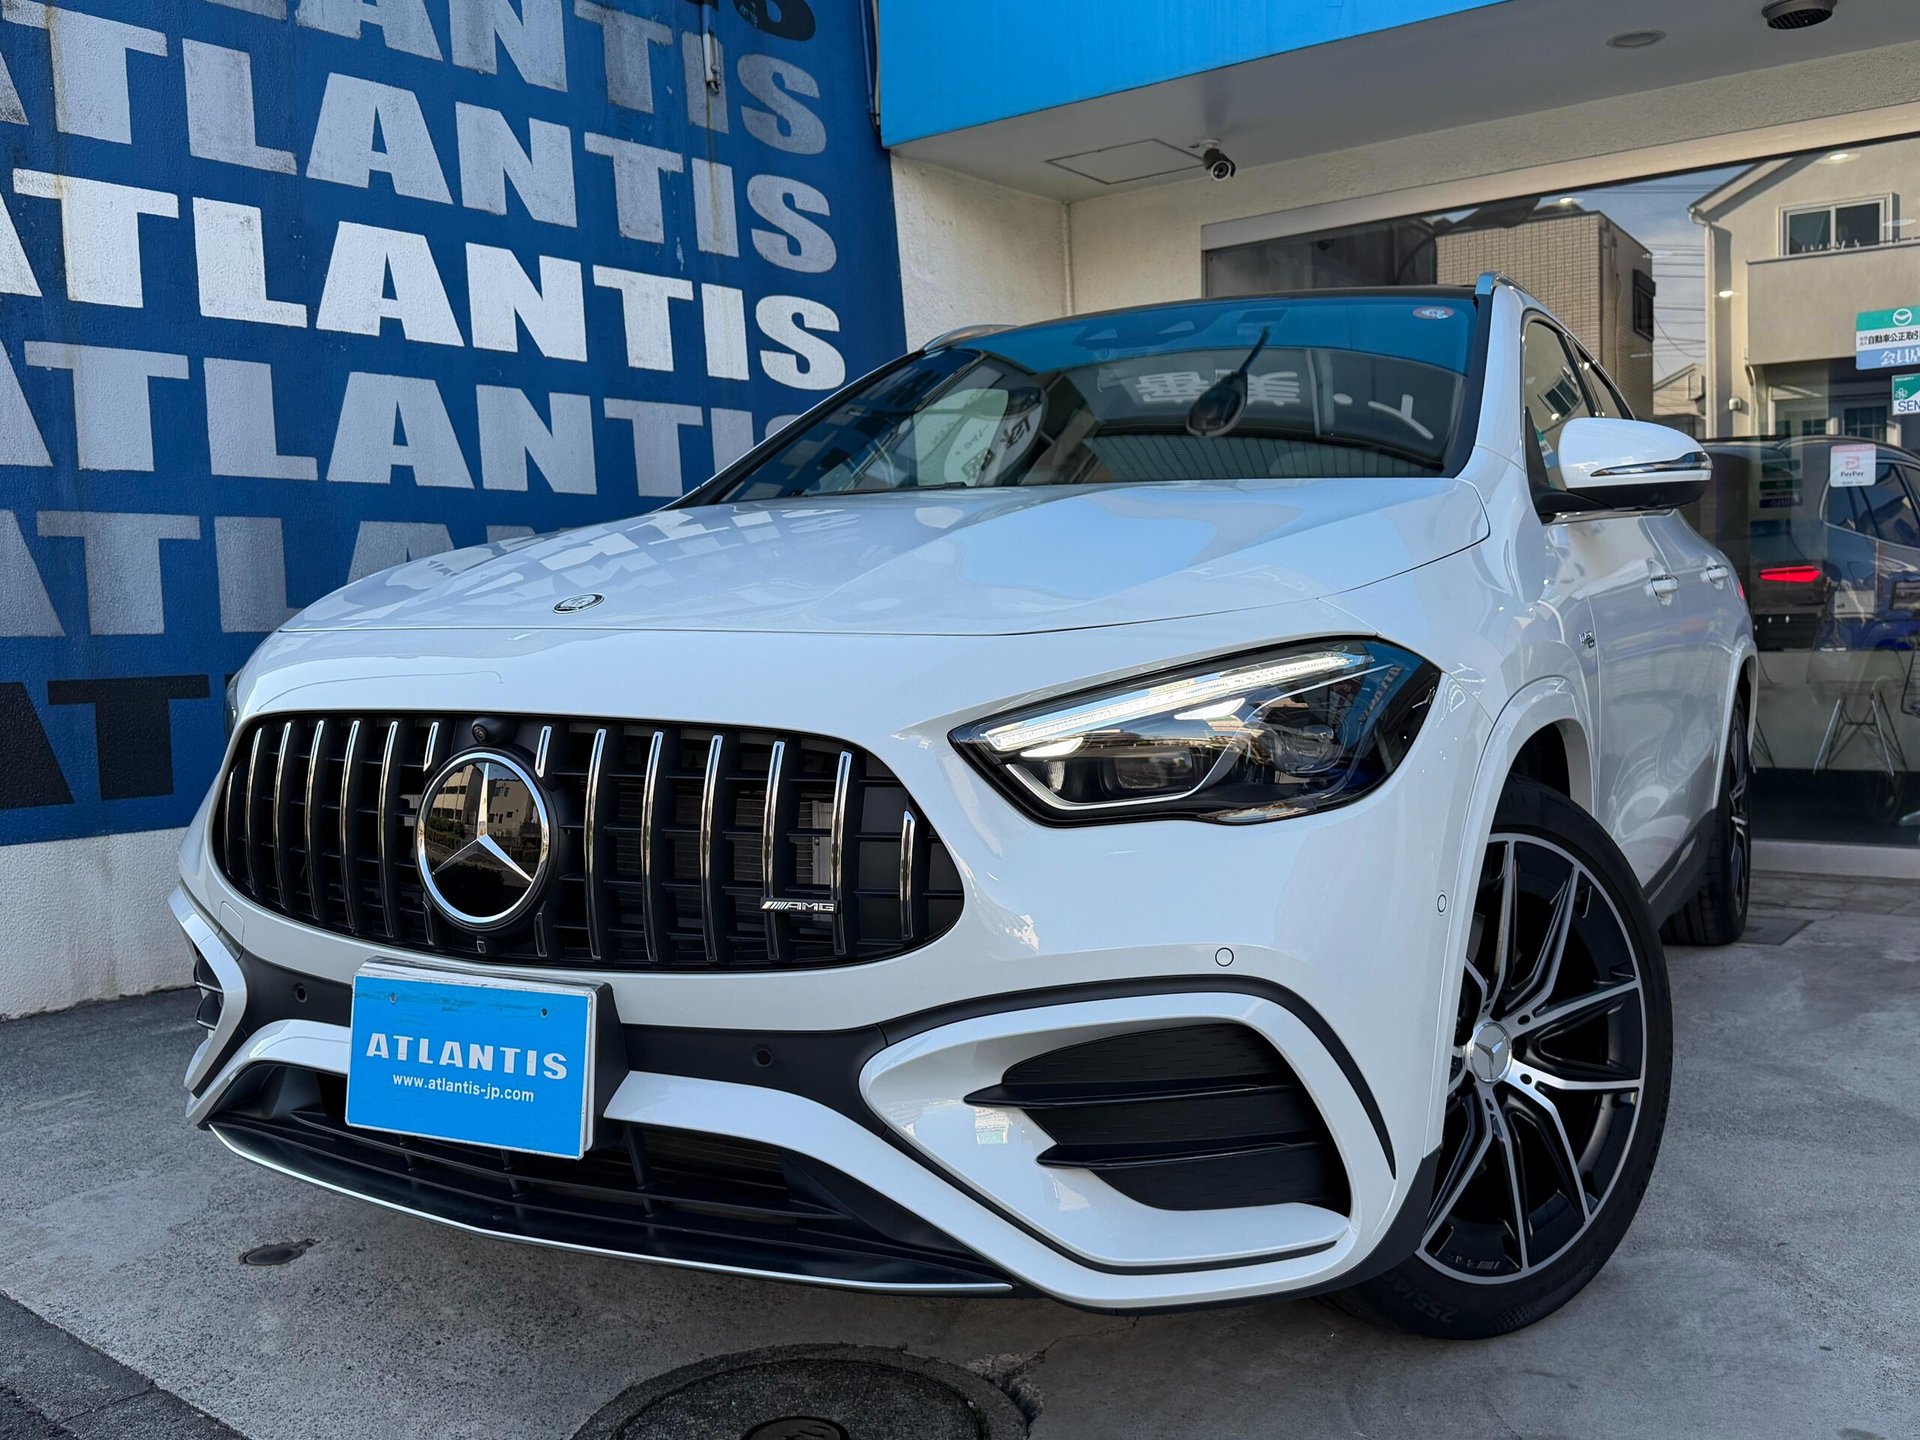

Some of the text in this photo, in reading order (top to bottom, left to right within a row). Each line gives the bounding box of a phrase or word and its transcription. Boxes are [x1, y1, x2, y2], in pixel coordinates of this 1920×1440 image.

[0, 0, 838, 273] TLANTIS
[0, 168, 846, 390] TLANTIS
[0, 338, 802, 497] TLANTI
[366, 1032, 568, 1080] ATLANTIS
[392, 1073, 534, 1102] www.atlantis-jp.com
